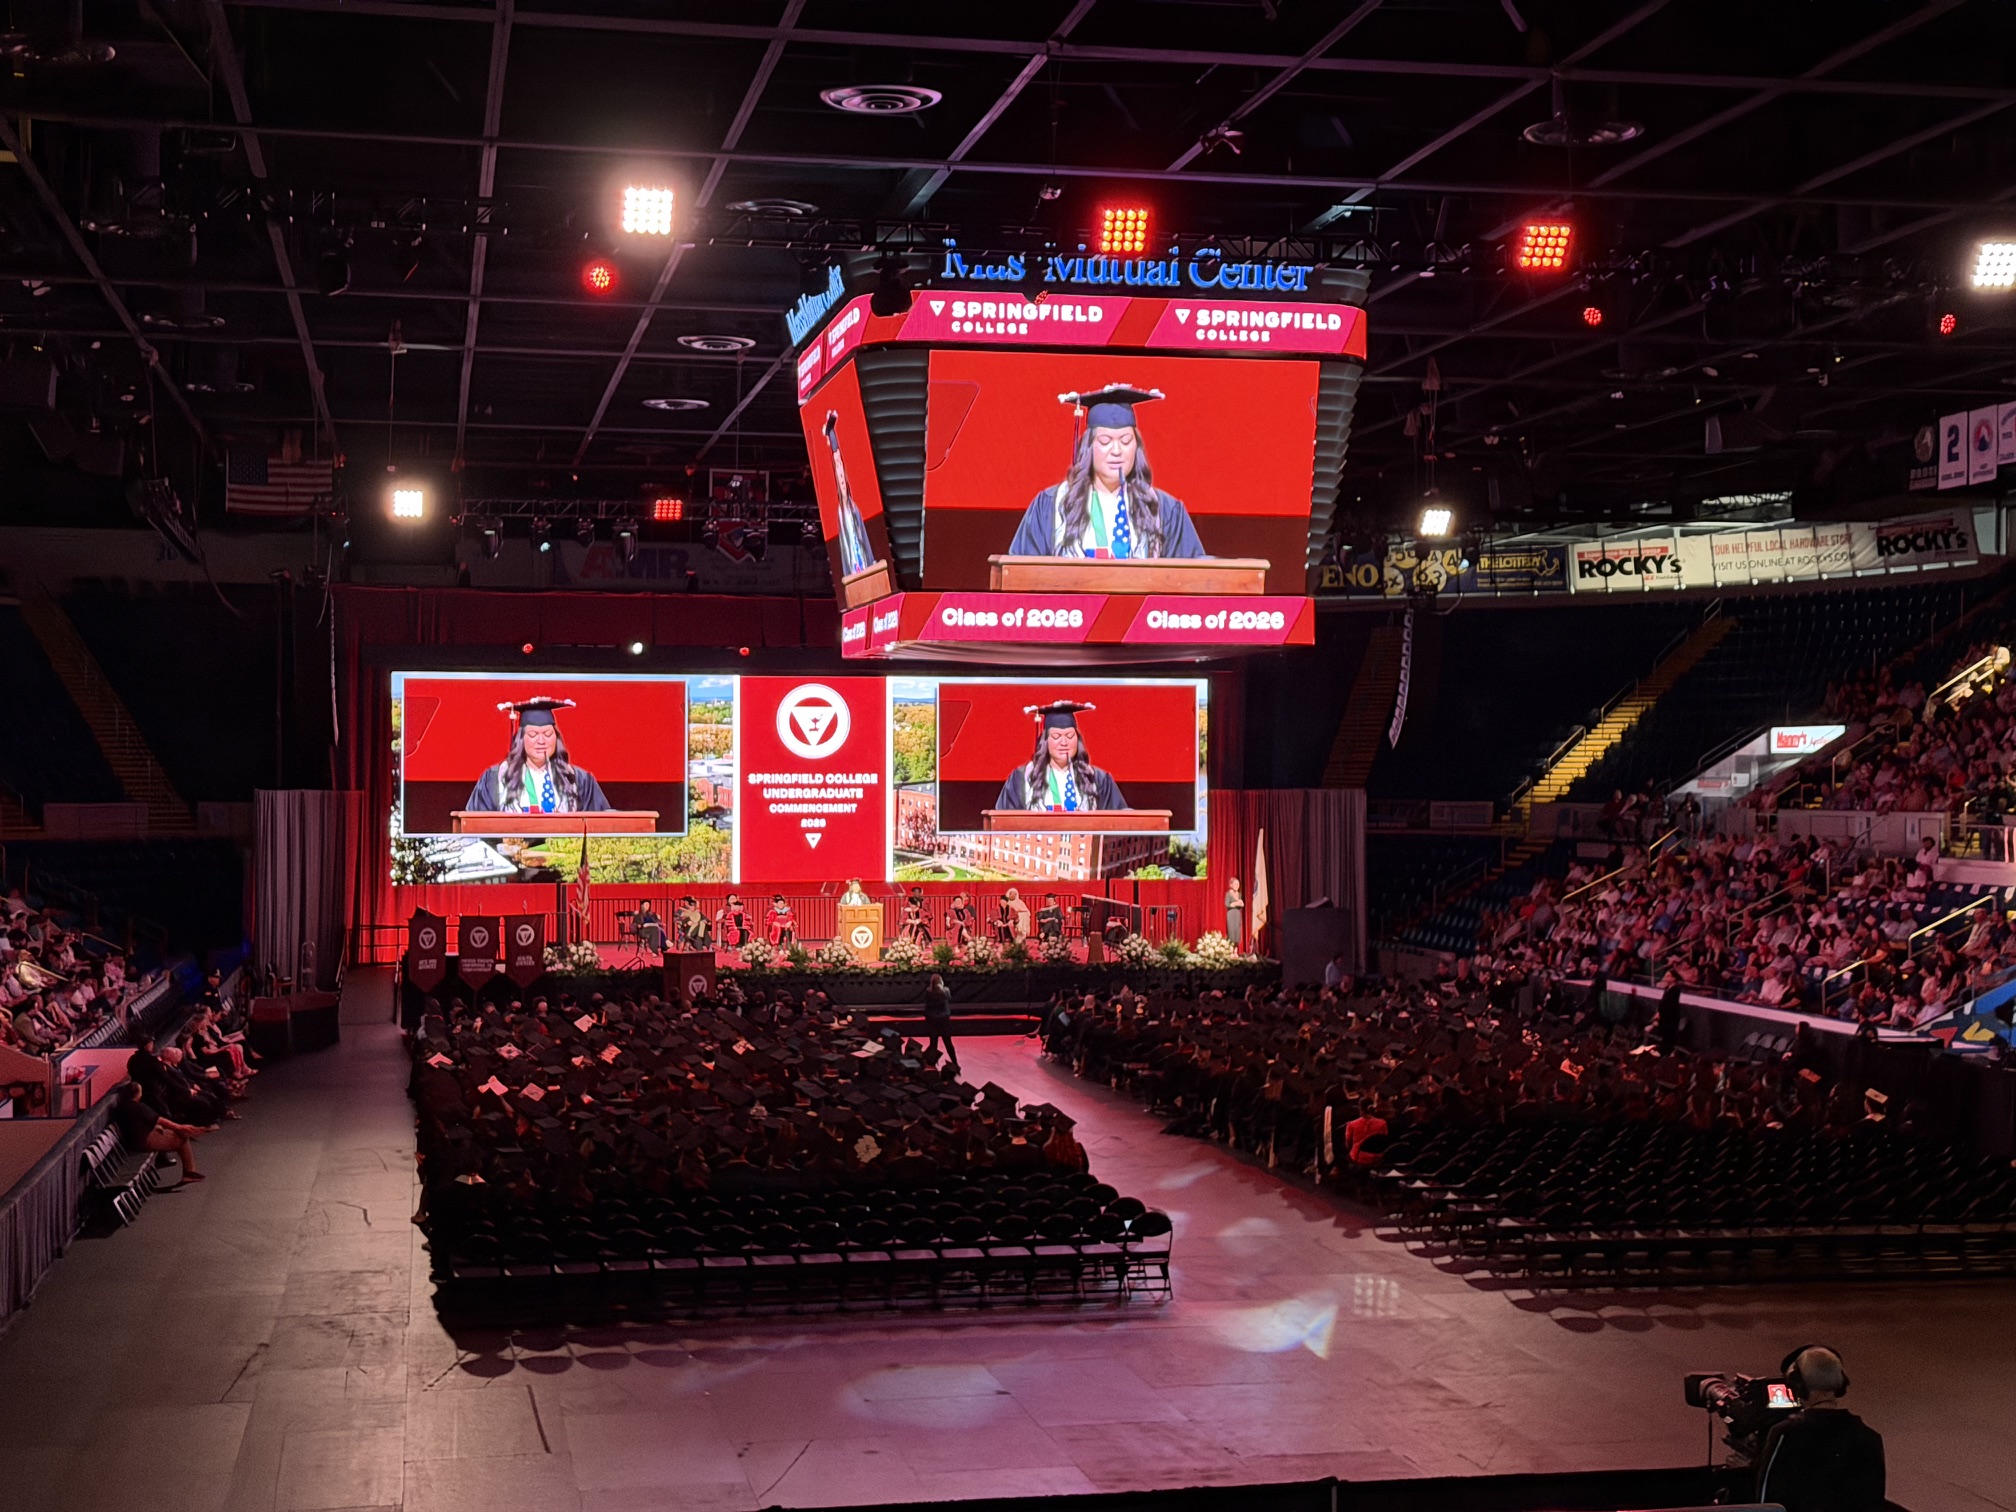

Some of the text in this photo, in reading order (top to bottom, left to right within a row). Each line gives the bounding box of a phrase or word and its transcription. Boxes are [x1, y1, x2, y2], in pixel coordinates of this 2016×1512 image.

[951, 301, 1103, 323] SPRINGFIELD
[1196, 309, 1342, 331] SPRINGFIELD
[951, 321, 1028, 335] COLLEGE
[1196, 329, 1271, 343] COLLEGE
[1947, 424, 1960, 463] 2
[1877, 527, 1968, 556] ROCKY's
[1578, 554, 1683, 578] ROCKY's
[1748, 557, 1785, 569] ONLINE
[942, 607, 1083, 628] Class of 2026
[1147, 610, 1284, 630] Class of 2026
[748, 773, 878, 784] SPRINGFIELD COLLEGE
[763, 788, 863, 799] UNDERGRADUATE
[769, 803, 858, 813] COMMENCEMENT
